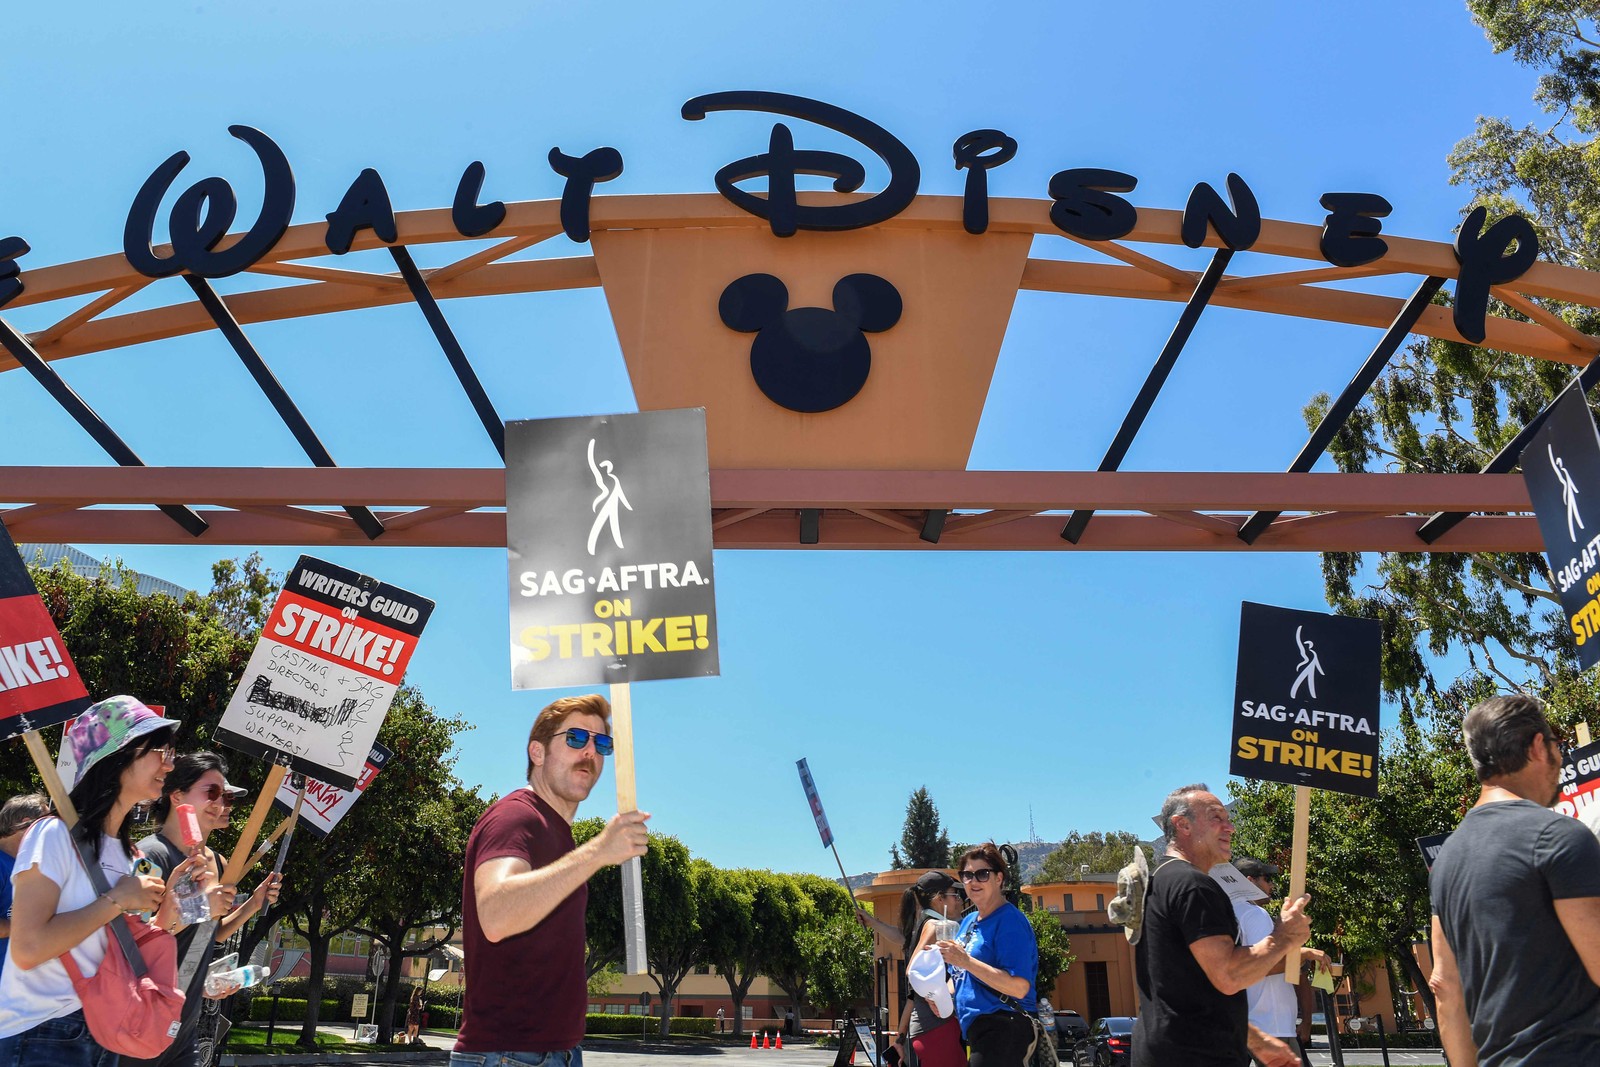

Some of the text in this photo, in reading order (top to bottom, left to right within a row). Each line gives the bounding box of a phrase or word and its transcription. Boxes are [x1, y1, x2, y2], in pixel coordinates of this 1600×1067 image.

[123, 124, 623, 279] WALT
[298, 569, 419, 625] WRITERS GUILD
[342, 607, 359, 620] ON
[594, 599, 631, 618] ON
[274, 603, 405, 676] STRIKE!
[519, 614, 709, 662] STRIKE!
[0, 636, 70, 692] IKE!
[267, 660, 328, 698] DIRECTORS
[271, 645, 329, 679] CASTING
[348, 676, 384, 699] SAG
[245, 705, 306, 735] SUPPORT
[1291, 729, 1318, 744] ON
[245, 721, 310, 756] WRITERS!
[1237, 735, 1373, 779] STRIKE!
[1562, 782, 1578, 796] ON
